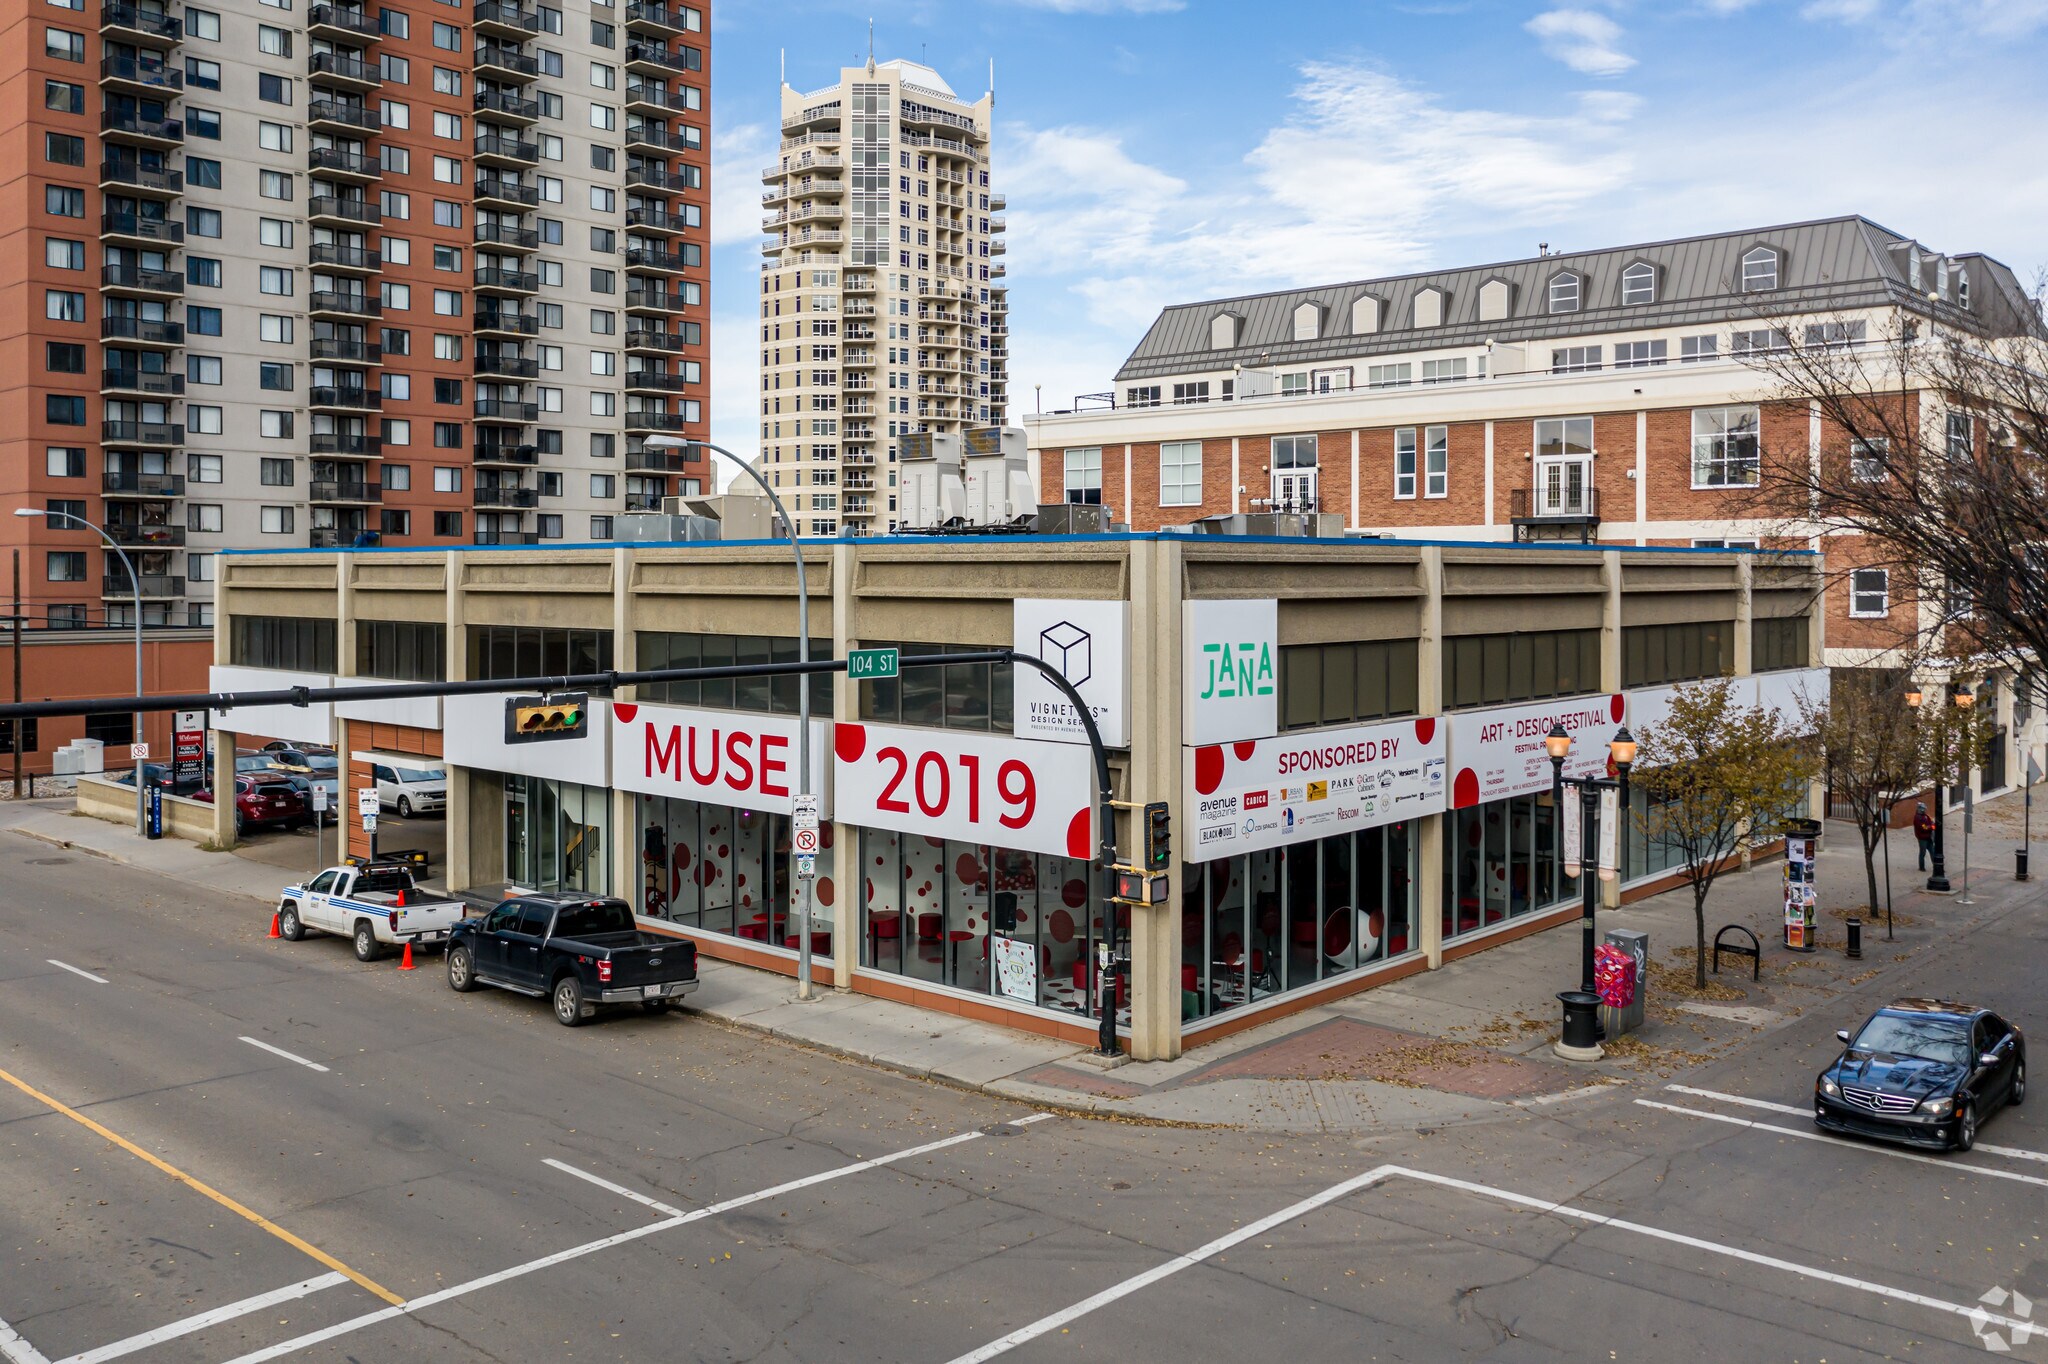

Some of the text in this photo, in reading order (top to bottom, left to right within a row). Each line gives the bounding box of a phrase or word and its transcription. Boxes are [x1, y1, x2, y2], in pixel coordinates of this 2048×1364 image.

[852, 654, 894, 673] 104 ST
[1200, 641, 1274, 700] JANA
[1031, 715, 1099, 728] DESIGN SERS
[1480, 722, 1504, 744] ART
[1516, 715, 1558, 738] DESIGN
[1560, 709, 1606, 731] FESTIVAL
[178, 734, 202, 742] Welcome
[1514, 741, 1539, 754] FESTIVAL
[644, 722, 791, 797] MUSE
[1278, 737, 1400, 775] SPONSORED BY
[1331, 777, 1354, 790] PARK
[1362, 773, 1375, 784] Gem
[875, 745, 1038, 830] 2019
[1357, 782, 1376, 793] Cabinets
[1200, 796, 1237, 812] avenue
[1200, 806, 1237, 821] magazine
[1262, 821, 1278, 830] SPACES
[1203, 827, 1233, 841] BLACK DOG
